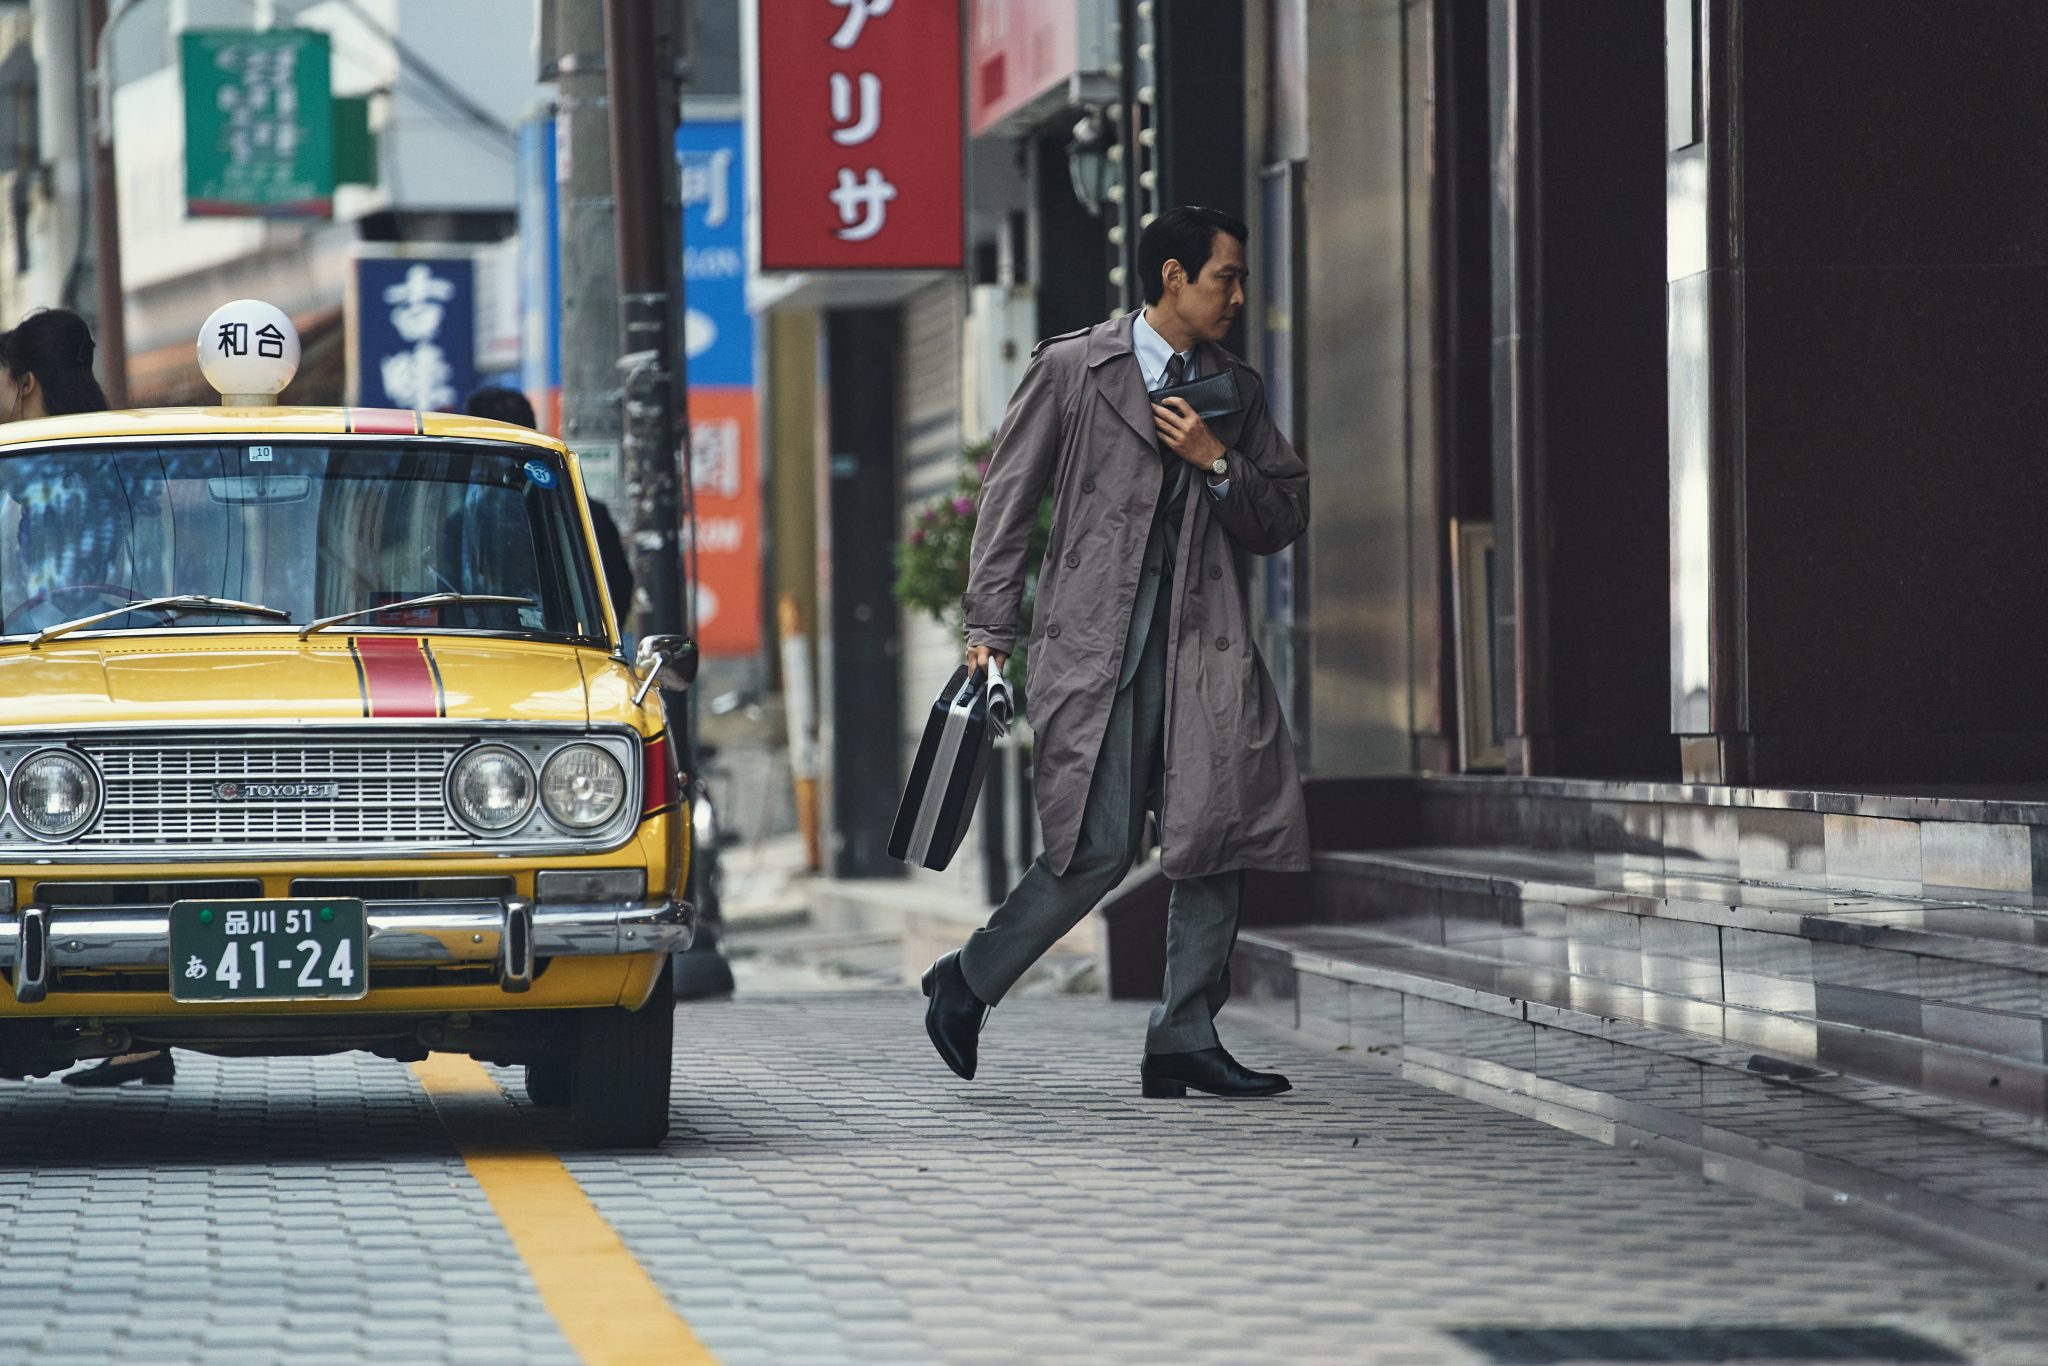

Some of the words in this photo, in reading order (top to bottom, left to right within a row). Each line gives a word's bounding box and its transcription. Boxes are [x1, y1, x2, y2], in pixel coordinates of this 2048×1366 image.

[218, 322, 286, 359] 和合
[257, 447, 270, 457] 10
[245, 785, 331, 796] TOYOPET
[225, 910, 276, 935] 品川
[285, 909, 312, 934] 51
[184, 955, 208, 979] あ
[215, 938, 354, 990] 41-24
